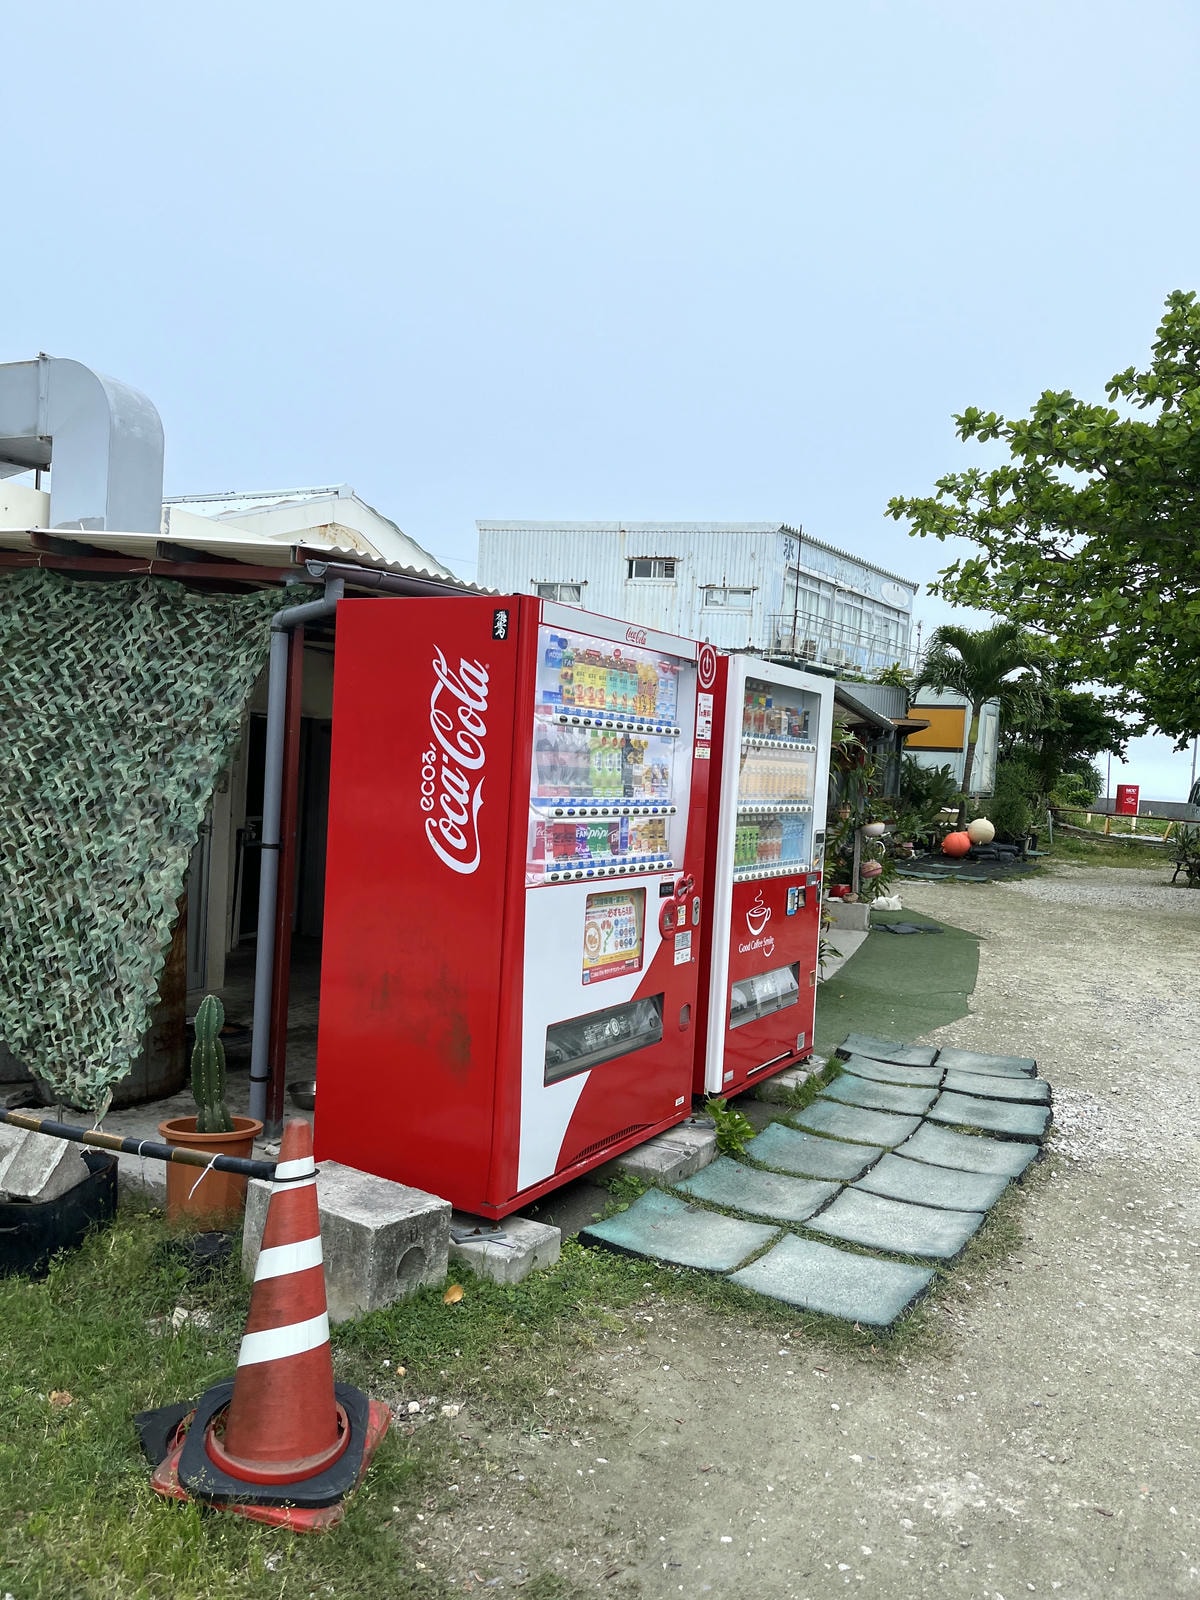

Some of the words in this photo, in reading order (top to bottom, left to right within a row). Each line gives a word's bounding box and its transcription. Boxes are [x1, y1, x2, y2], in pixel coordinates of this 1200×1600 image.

[425, 643, 490, 875] Coca-Cola
[738, 941, 751, 953] Good
[751, 939, 763, 950] Coffee
[763, 936, 774, 946] Smile
